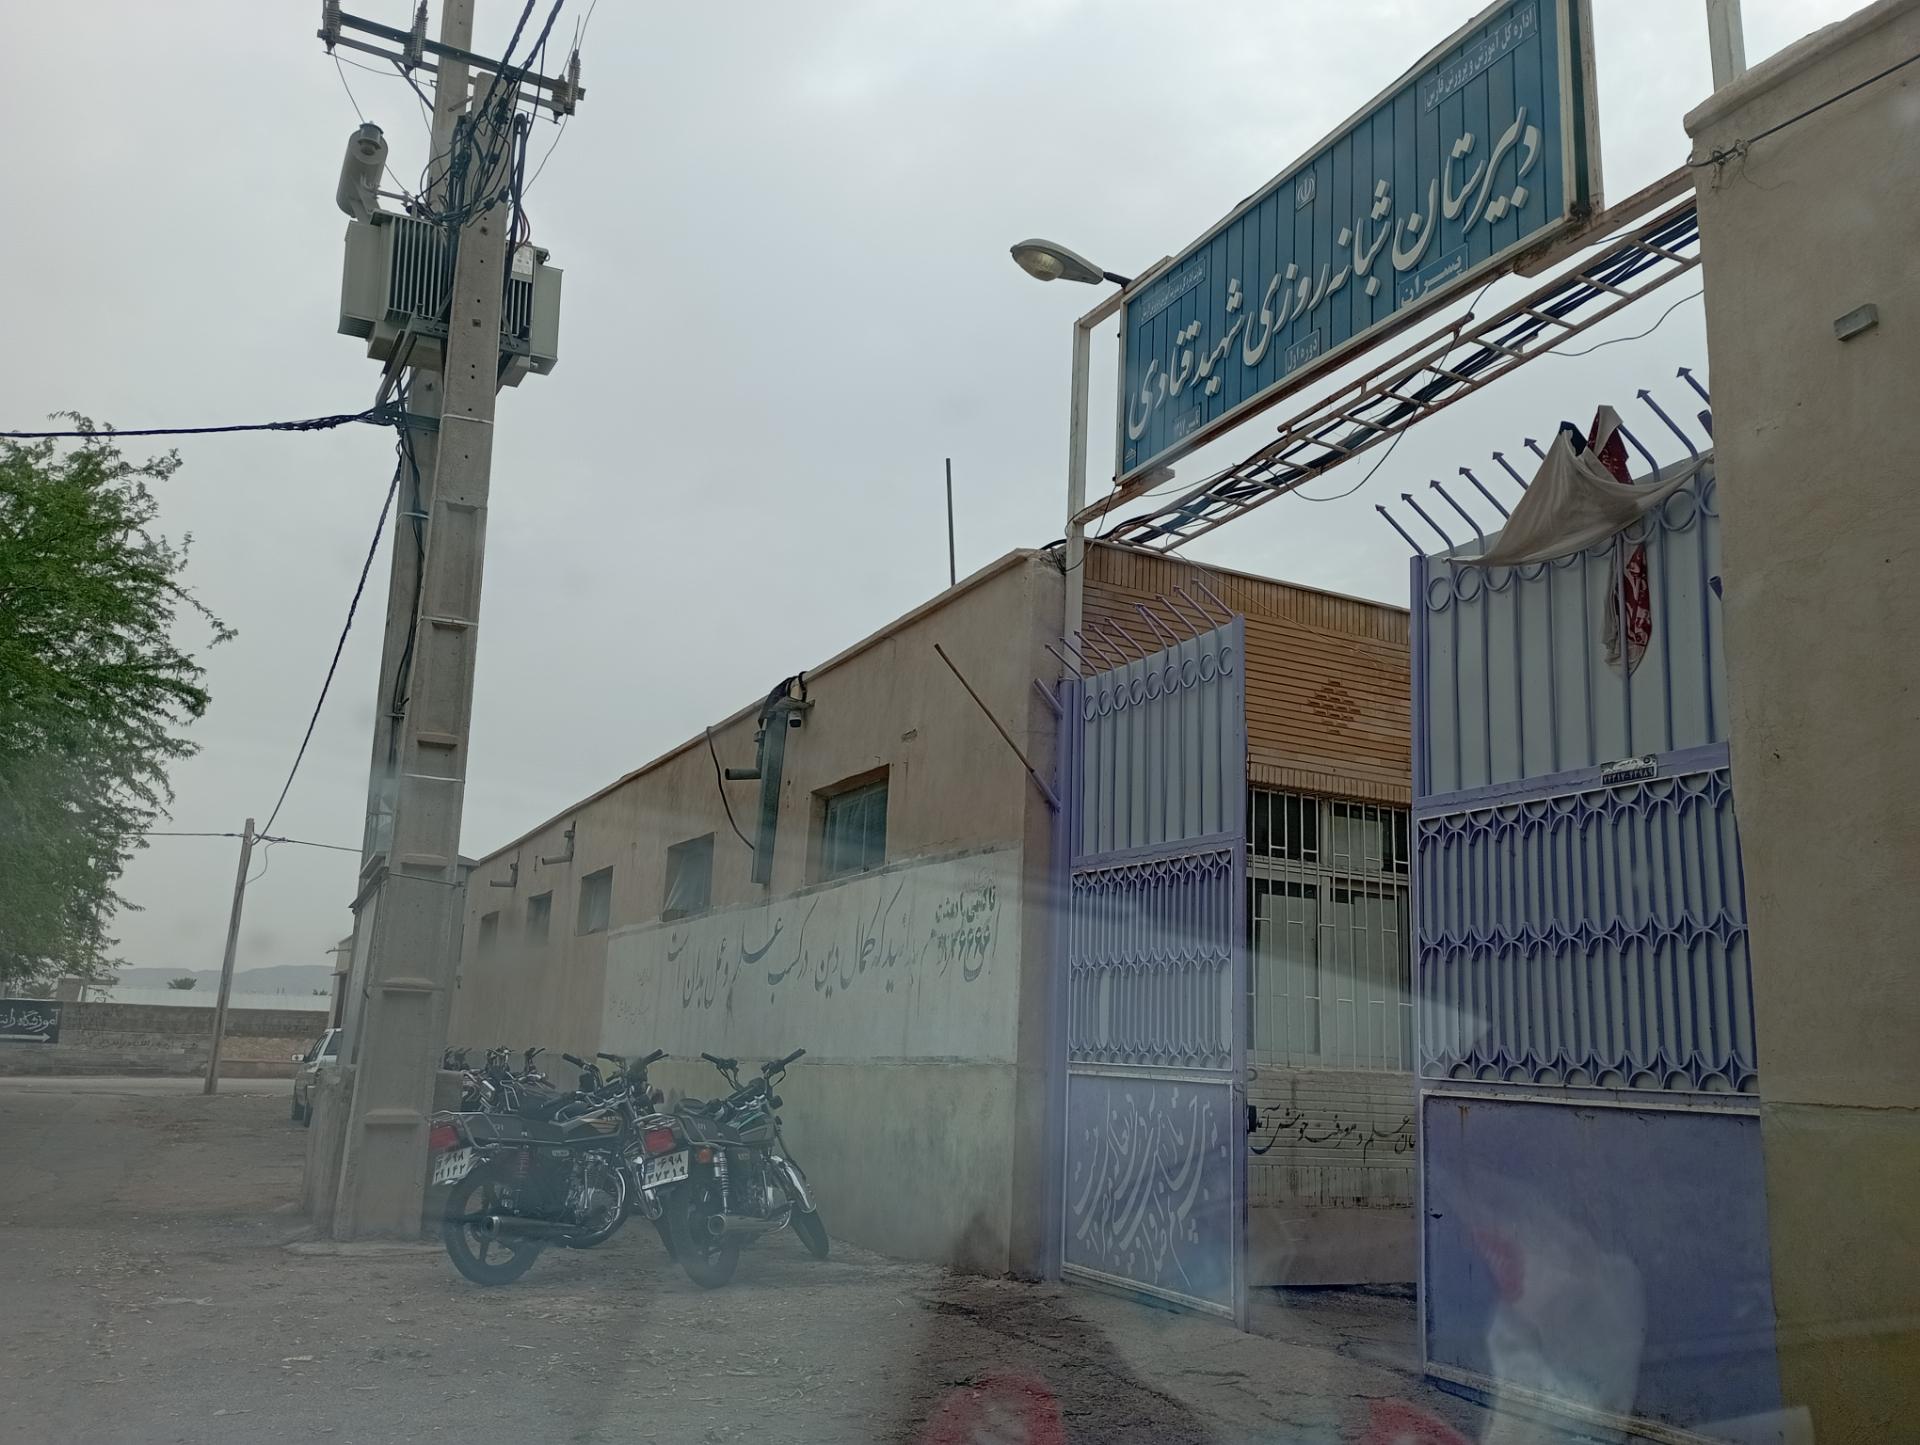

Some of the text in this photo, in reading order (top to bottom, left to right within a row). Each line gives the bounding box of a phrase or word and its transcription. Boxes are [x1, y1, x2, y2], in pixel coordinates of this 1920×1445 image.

[1391, 105, 1542, 272] دبیرستان
[1189, 278, 1246, 396] شهید
[1250, 1107, 1309, 1155] خوش
[1363, 1115, 1410, 1166] علم
